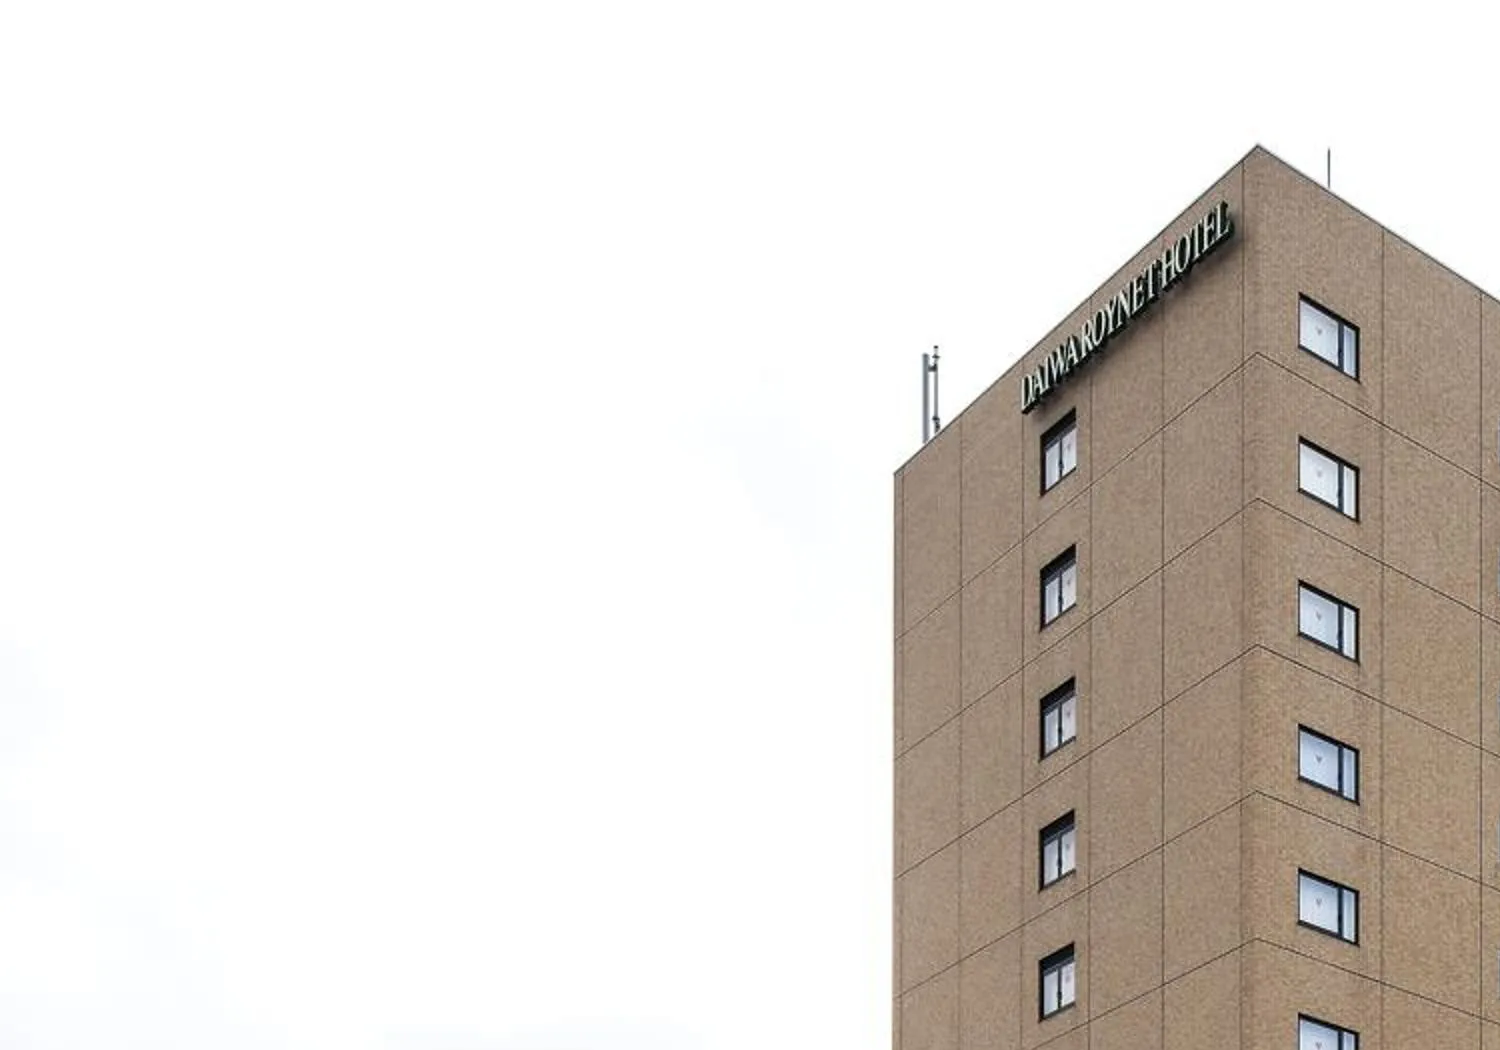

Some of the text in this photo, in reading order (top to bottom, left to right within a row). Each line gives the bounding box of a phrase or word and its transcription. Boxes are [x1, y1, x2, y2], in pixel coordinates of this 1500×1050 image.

[1021, 201, 1232, 413] DAIWA ROYNET HOTEL
